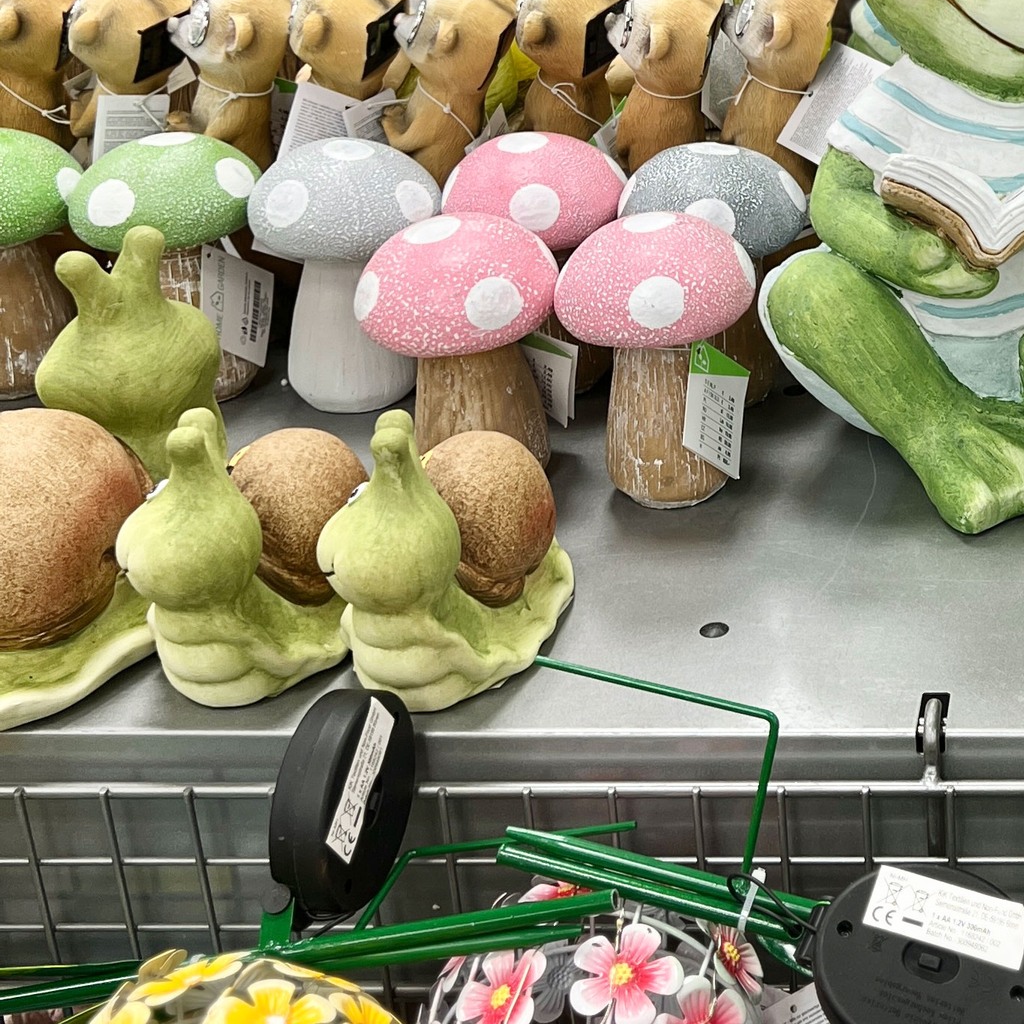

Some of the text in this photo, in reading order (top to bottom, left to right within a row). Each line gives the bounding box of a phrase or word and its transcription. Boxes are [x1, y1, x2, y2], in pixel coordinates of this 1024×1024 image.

[217, 257, 225, 291] GARDEN
[941, 915, 951, 923] AA
[953, 918, 966, 927] 1.2V
